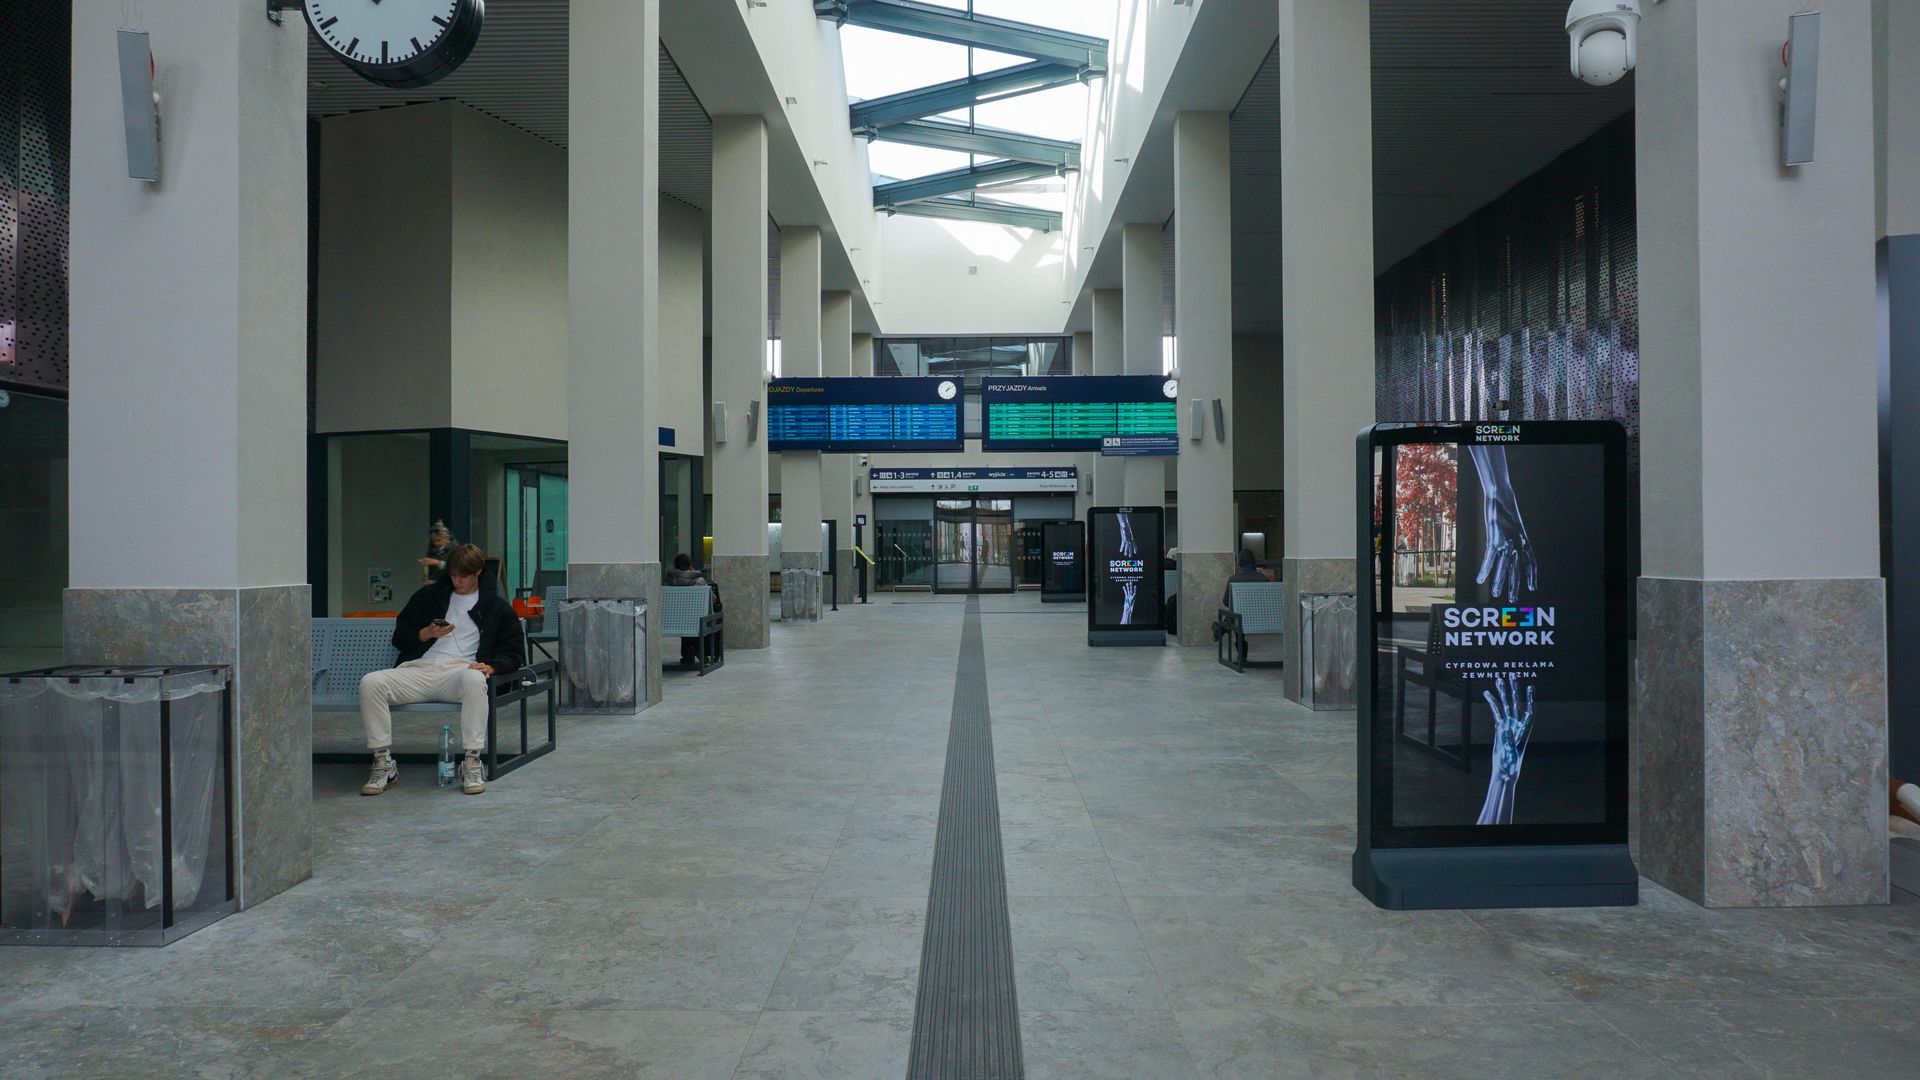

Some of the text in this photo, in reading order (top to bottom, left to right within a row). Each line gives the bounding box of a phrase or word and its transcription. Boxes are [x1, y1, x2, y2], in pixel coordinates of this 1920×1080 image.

[1475, 425, 1521, 434] SCREEN
[1444, 606, 1555, 628] SCREEN
[1445, 631, 1555, 646] NETWORK
